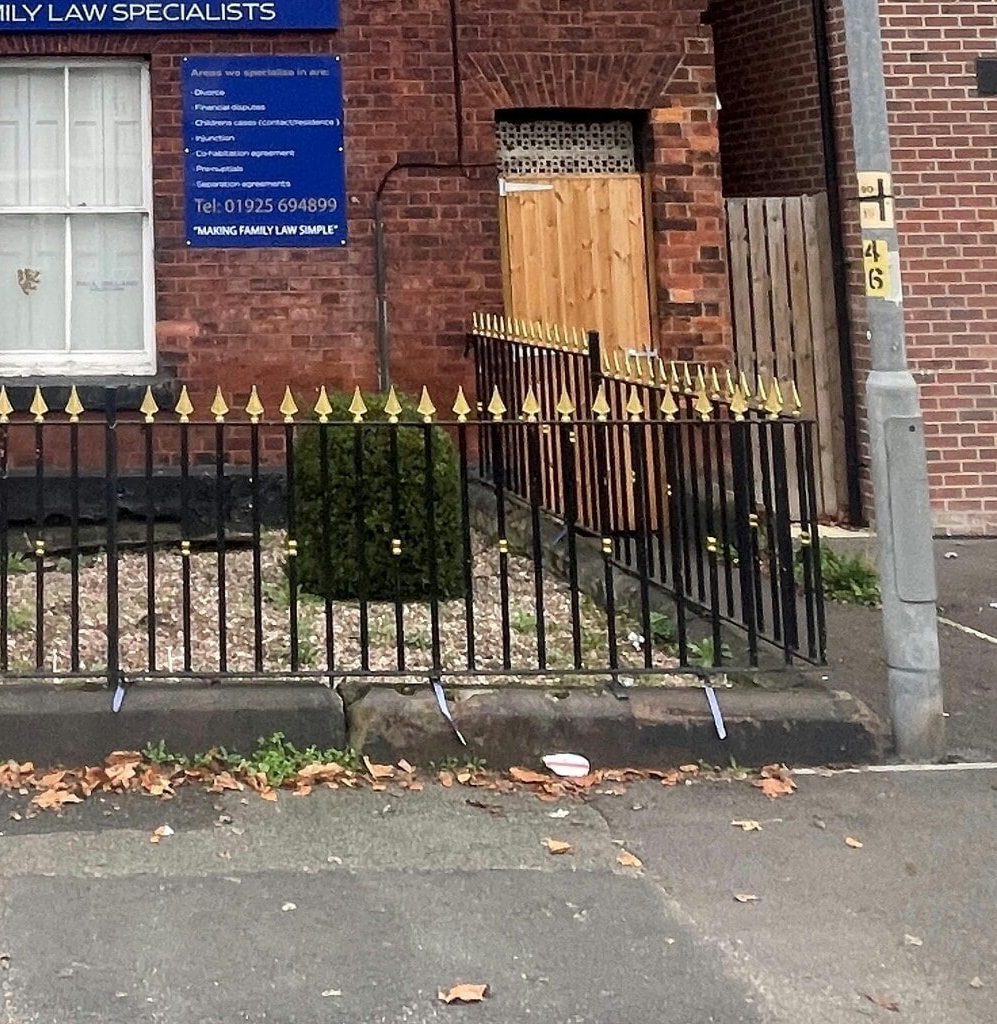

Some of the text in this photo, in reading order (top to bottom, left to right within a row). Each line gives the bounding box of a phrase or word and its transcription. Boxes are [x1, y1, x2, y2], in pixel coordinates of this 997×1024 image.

[48, 3, 106, 22] LAW
[112, 2, 277, 22] SPECIALISTS
[296, 68, 308, 77] in
[194, 88, 226, 96] Divorce
[195, 103, 266, 112] Financial disputes
[195, 135, 236, 143] Injunction
[196, 180, 241, 188] Separation
[194, 197, 338, 214] Tel: 01925 694899
[238, 225, 274, 236] FAMILY
[275, 225, 298, 236] LAW
